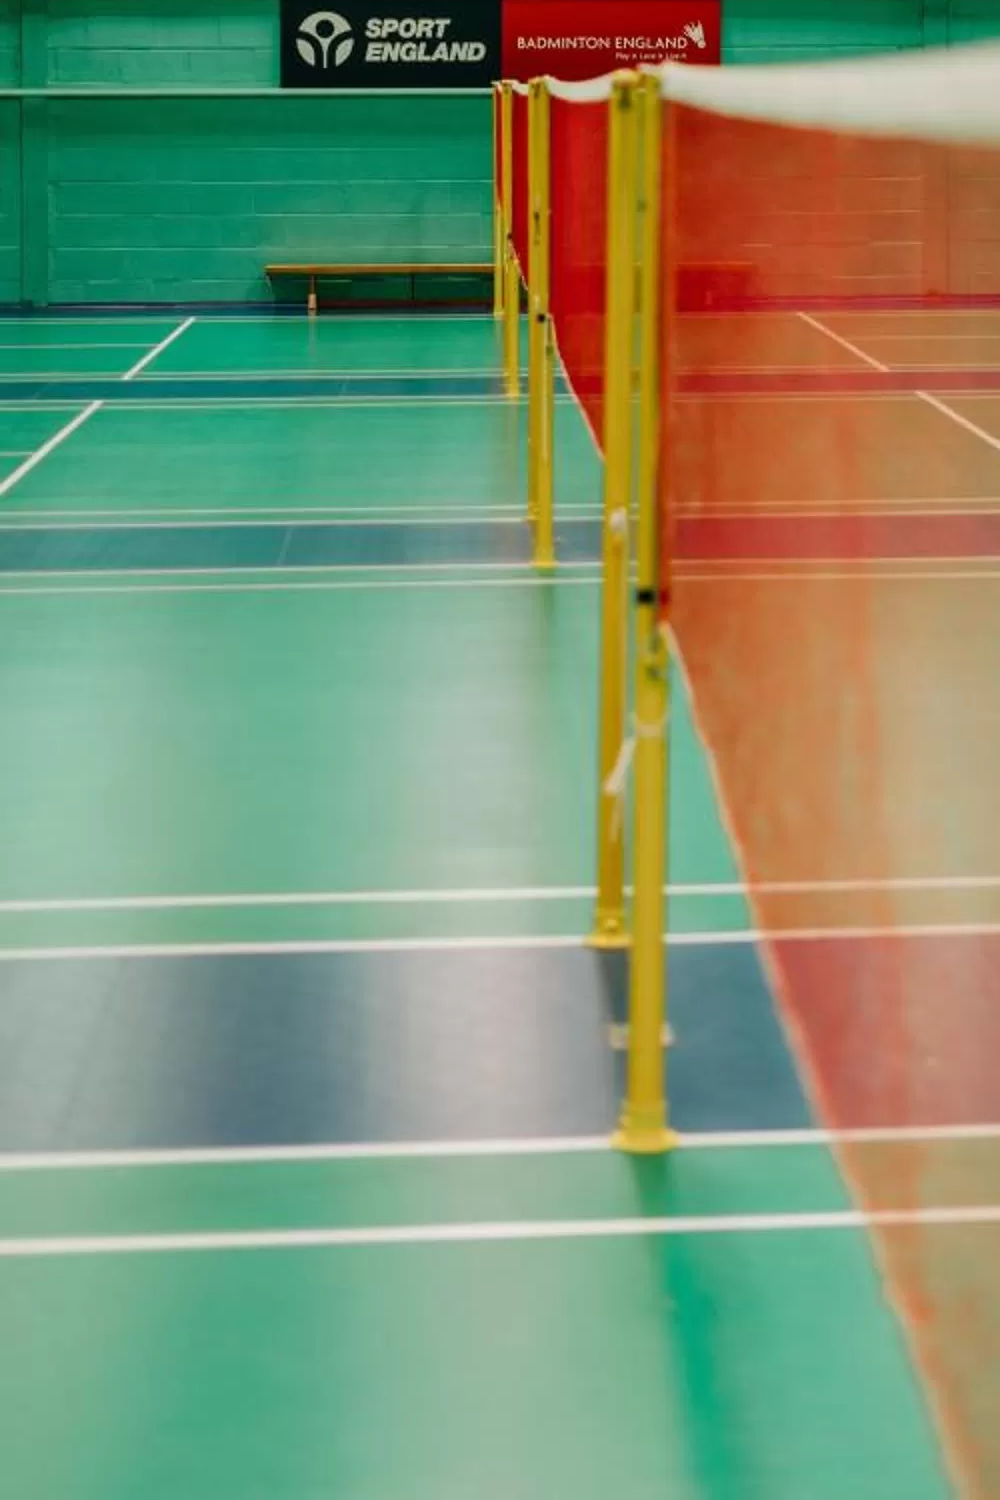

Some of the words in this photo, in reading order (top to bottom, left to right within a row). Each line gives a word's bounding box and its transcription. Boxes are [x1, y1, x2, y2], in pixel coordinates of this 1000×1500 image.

[365, 18, 451, 38] SPORT
[365, 42, 486, 62] ENGLAND
[517, 36, 611, 49] BADMINTON
[615, 36, 687, 49] ENGLAND
